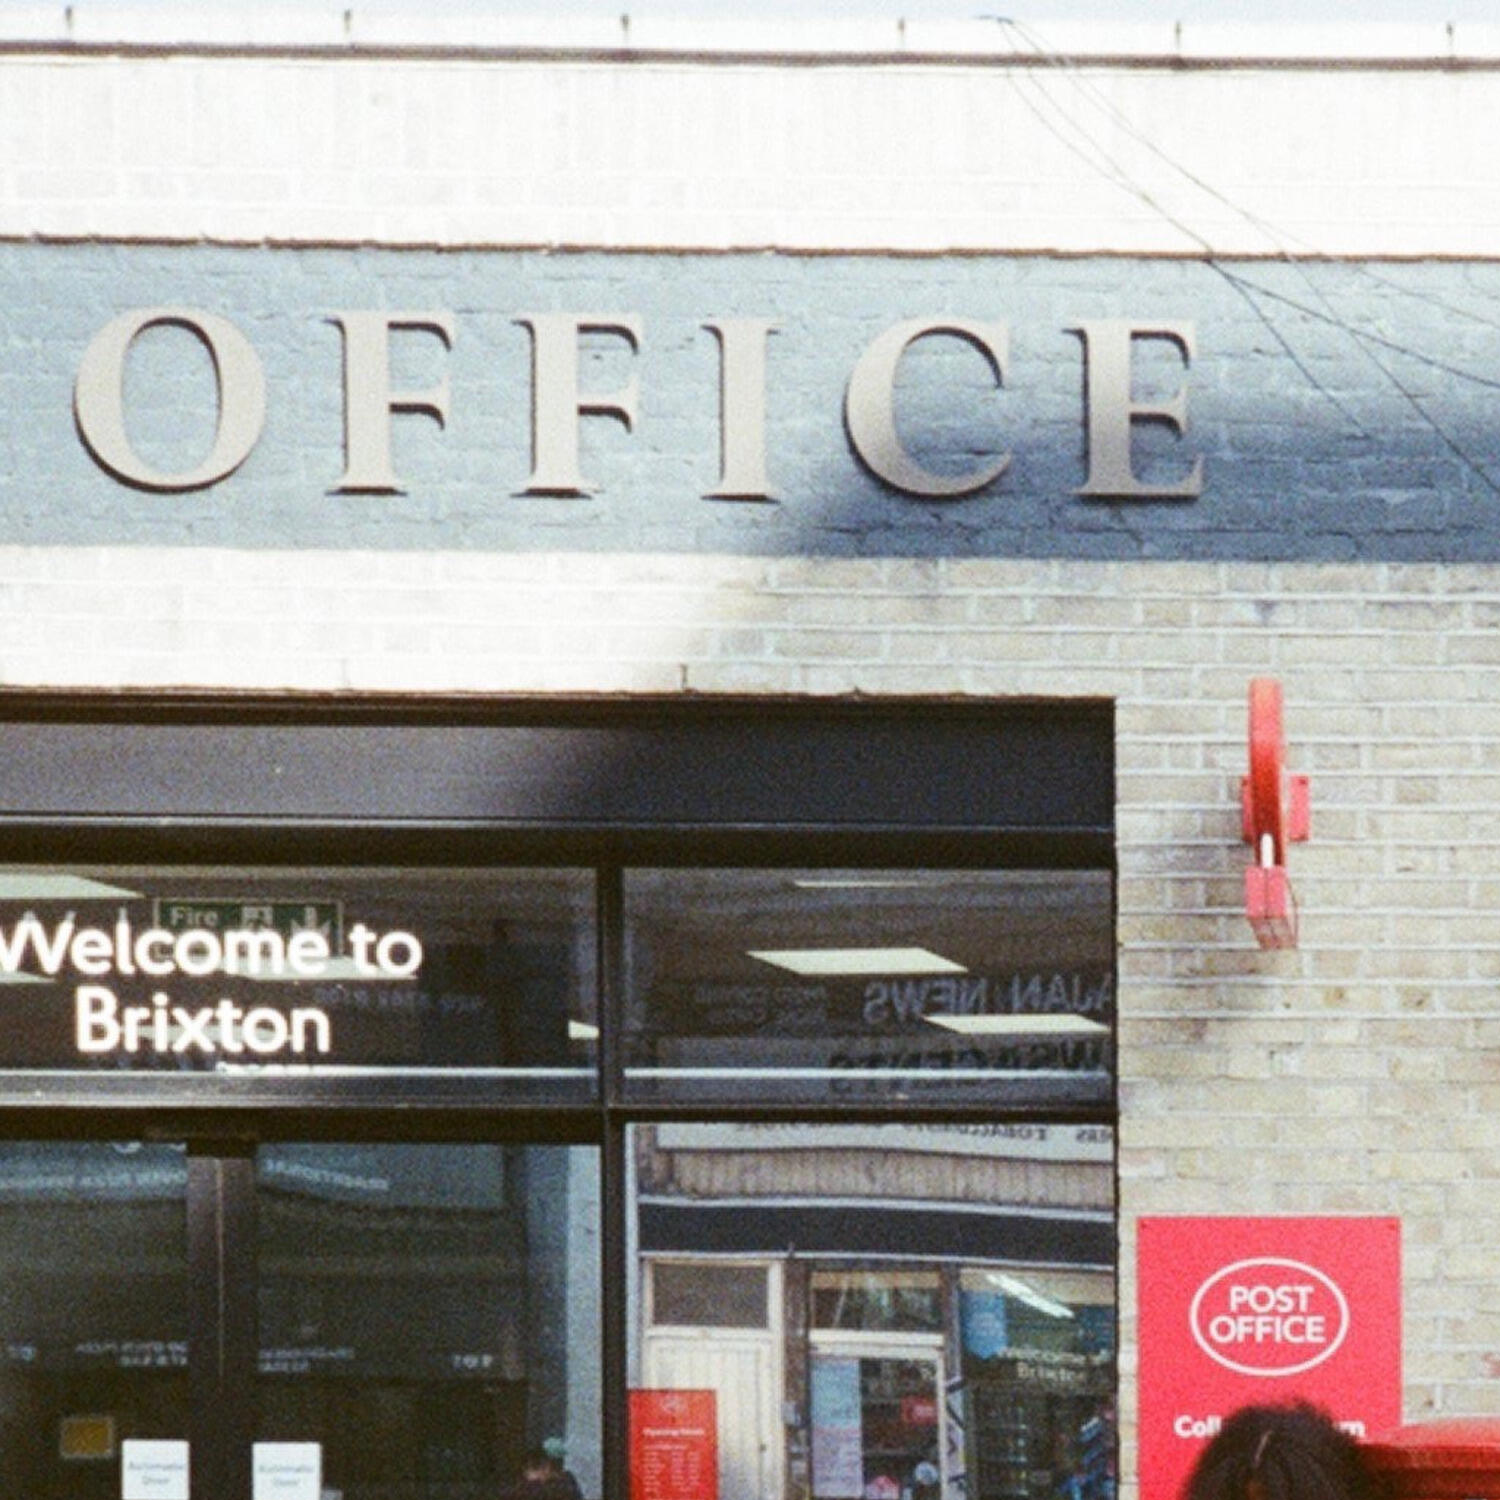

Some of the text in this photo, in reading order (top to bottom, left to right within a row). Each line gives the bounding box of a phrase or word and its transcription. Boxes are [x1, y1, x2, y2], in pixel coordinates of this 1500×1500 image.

[72, 305, 1205, 504] OFFICE
[170, 906, 219, 927] Fire
[0, 917, 423, 976] Welcome to
[75, 983, 331, 1054] Brixton
[1229, 1285, 1314, 1313] POST
[1208, 1315, 1326, 1343] OFFICE
